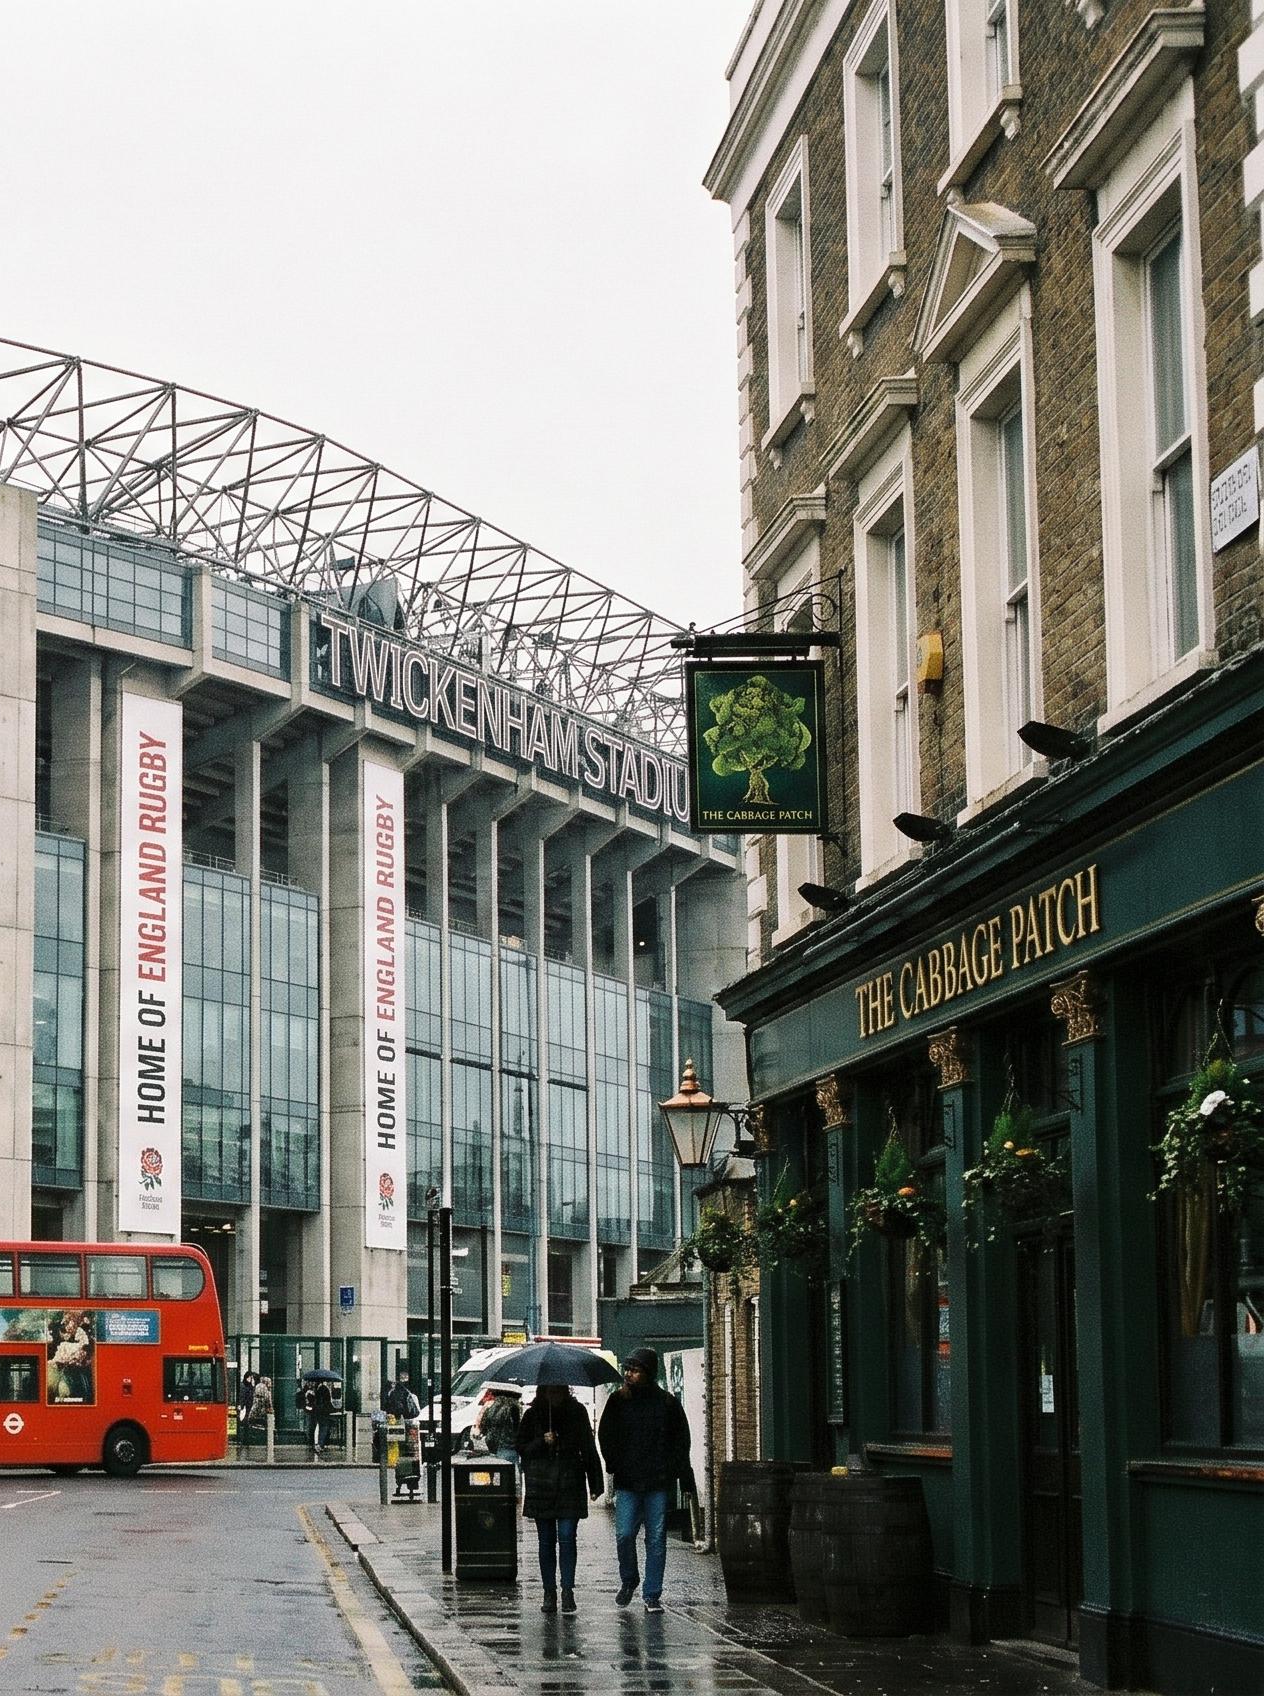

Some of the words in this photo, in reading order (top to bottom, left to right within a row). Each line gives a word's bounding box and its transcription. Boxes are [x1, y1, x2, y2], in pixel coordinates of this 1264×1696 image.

[321, 613, 580, 779] TWICKENHAM
[584, 726, 690, 823] STADIU
[139, 731, 167, 835] RUGBY
[702, 810, 724, 820] THE
[726, 810, 775, 820] CABBAGE
[779, 810, 813, 820] PATCH
[375, 794, 395, 889] RUGBY
[138, 841, 167, 983] ENGLAND
[376, 895, 396, 1022] ENGLAND
[855, 971, 896, 1039] THE
[899, 915, 1004, 1019] CABBAGE
[1009, 864, 1101, 970] PATCH
[138, 990, 166, 1028] OF
[377, 1028, 396, 1064] OF
[137, 1036, 166, 1124] HOME
[377, 1070, 396, 1150] HOME
